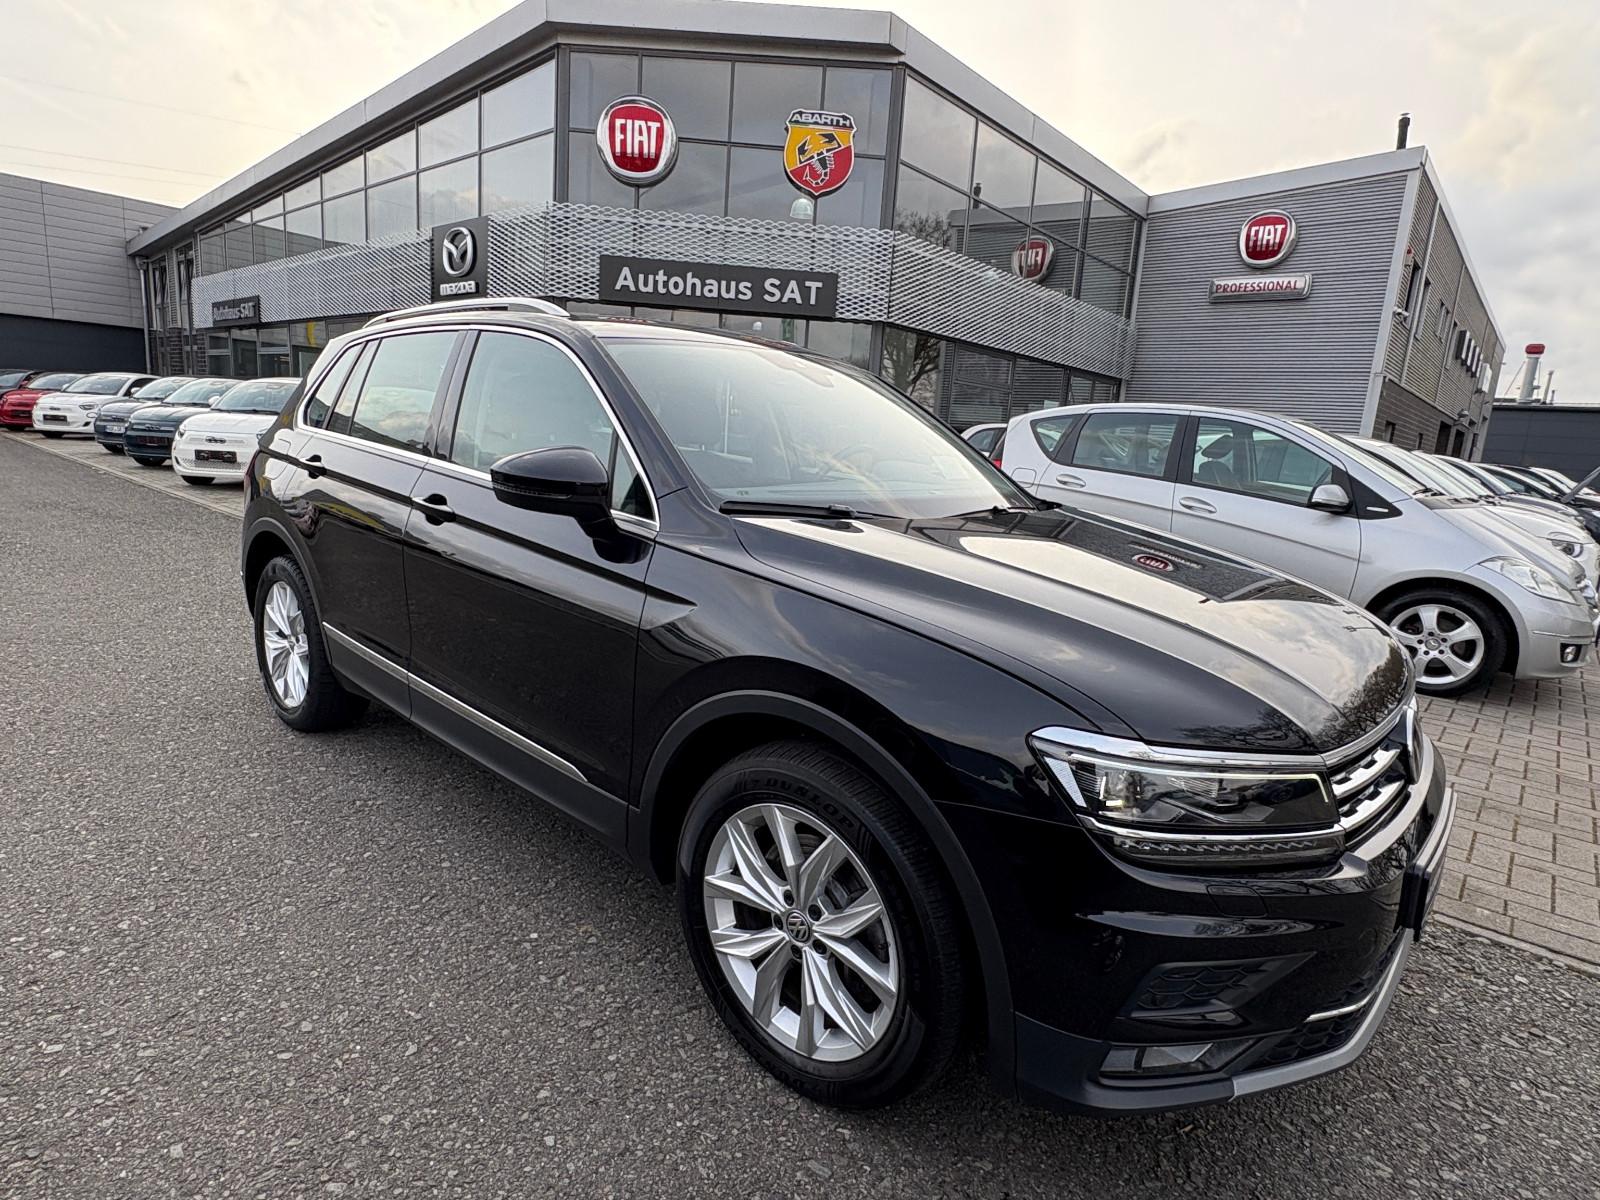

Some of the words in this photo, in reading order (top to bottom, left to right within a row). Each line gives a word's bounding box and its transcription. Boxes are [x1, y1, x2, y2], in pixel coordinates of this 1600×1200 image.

[791, 113, 850, 127] ABARTH
[614, 118, 661, 159] FIAT
[1248, 224, 1286, 252] FIAT
[614, 266, 753, 300] Autohaus
[763, 277, 823, 305] SAT
[1215, 279, 1298, 294] PROFESSIONAL
